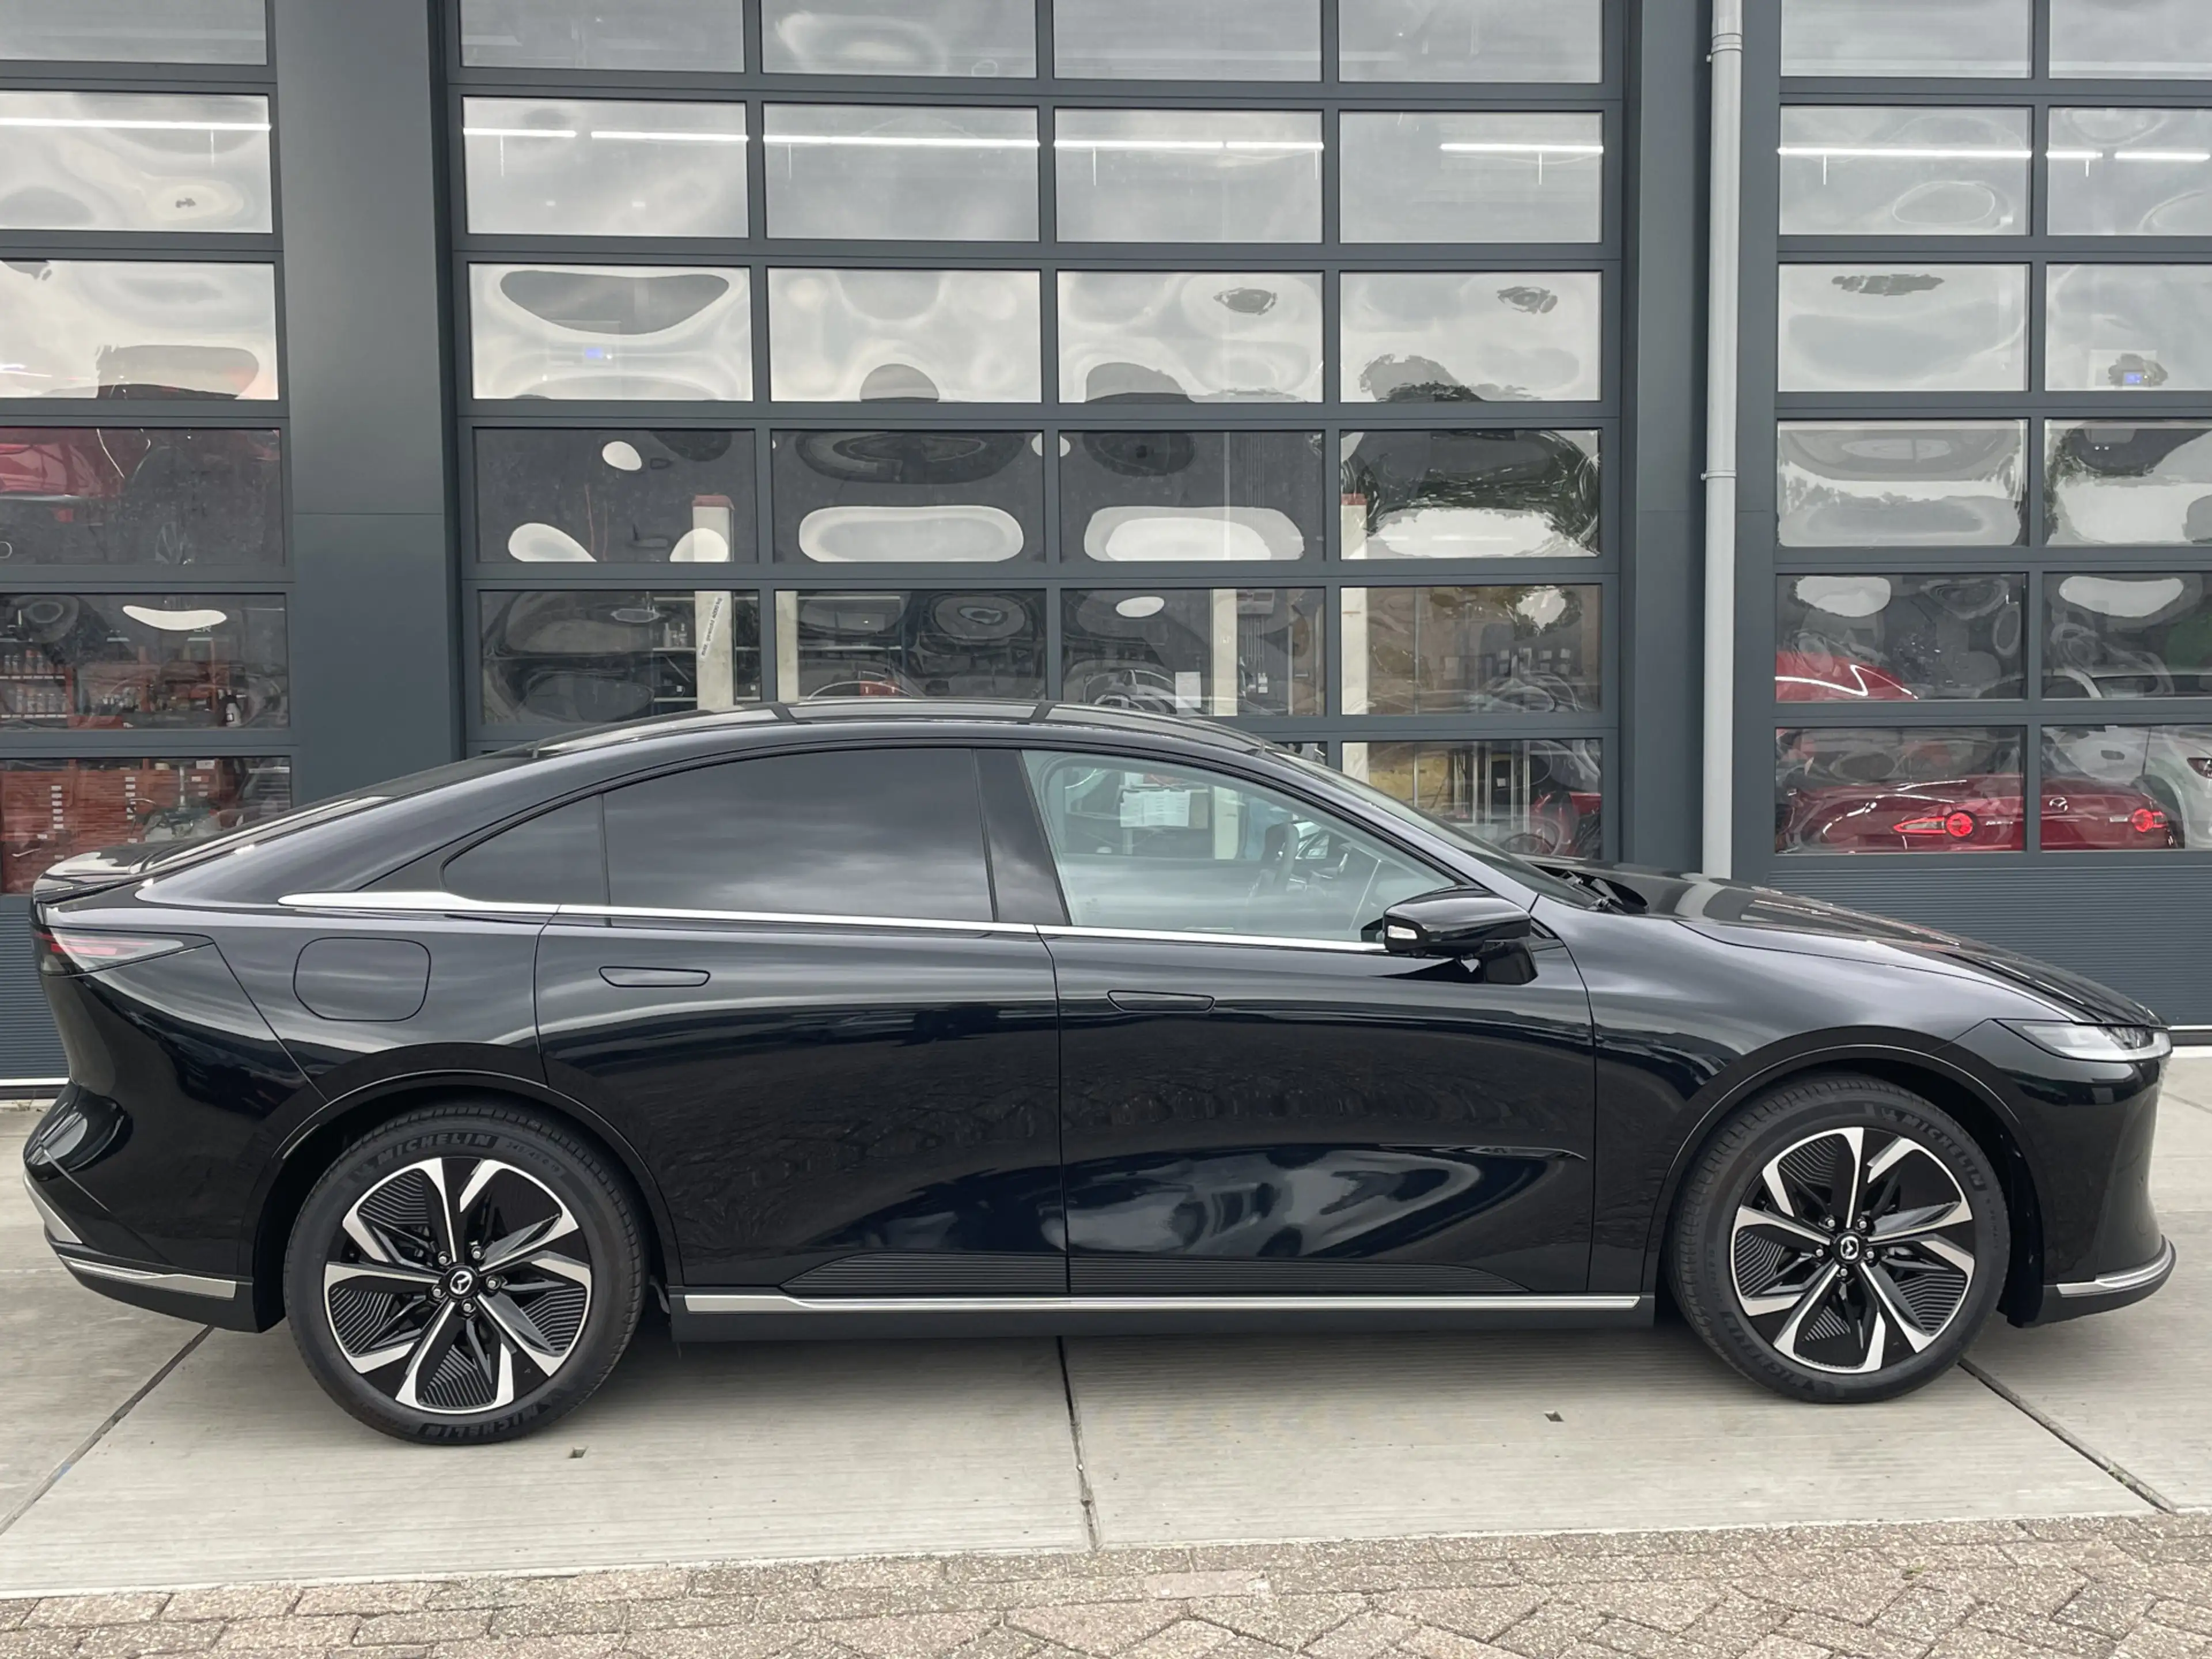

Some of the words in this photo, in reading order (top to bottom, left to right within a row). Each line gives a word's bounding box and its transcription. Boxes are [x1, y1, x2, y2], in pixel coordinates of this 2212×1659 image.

[377, 1133, 492, 1165] MICHELIN
[1901, 1115, 1984, 1188] MICHELIN
[1722, 1315, 1808, 1391] MICHELIN
[422, 1402, 540, 1438] MICHELIN
